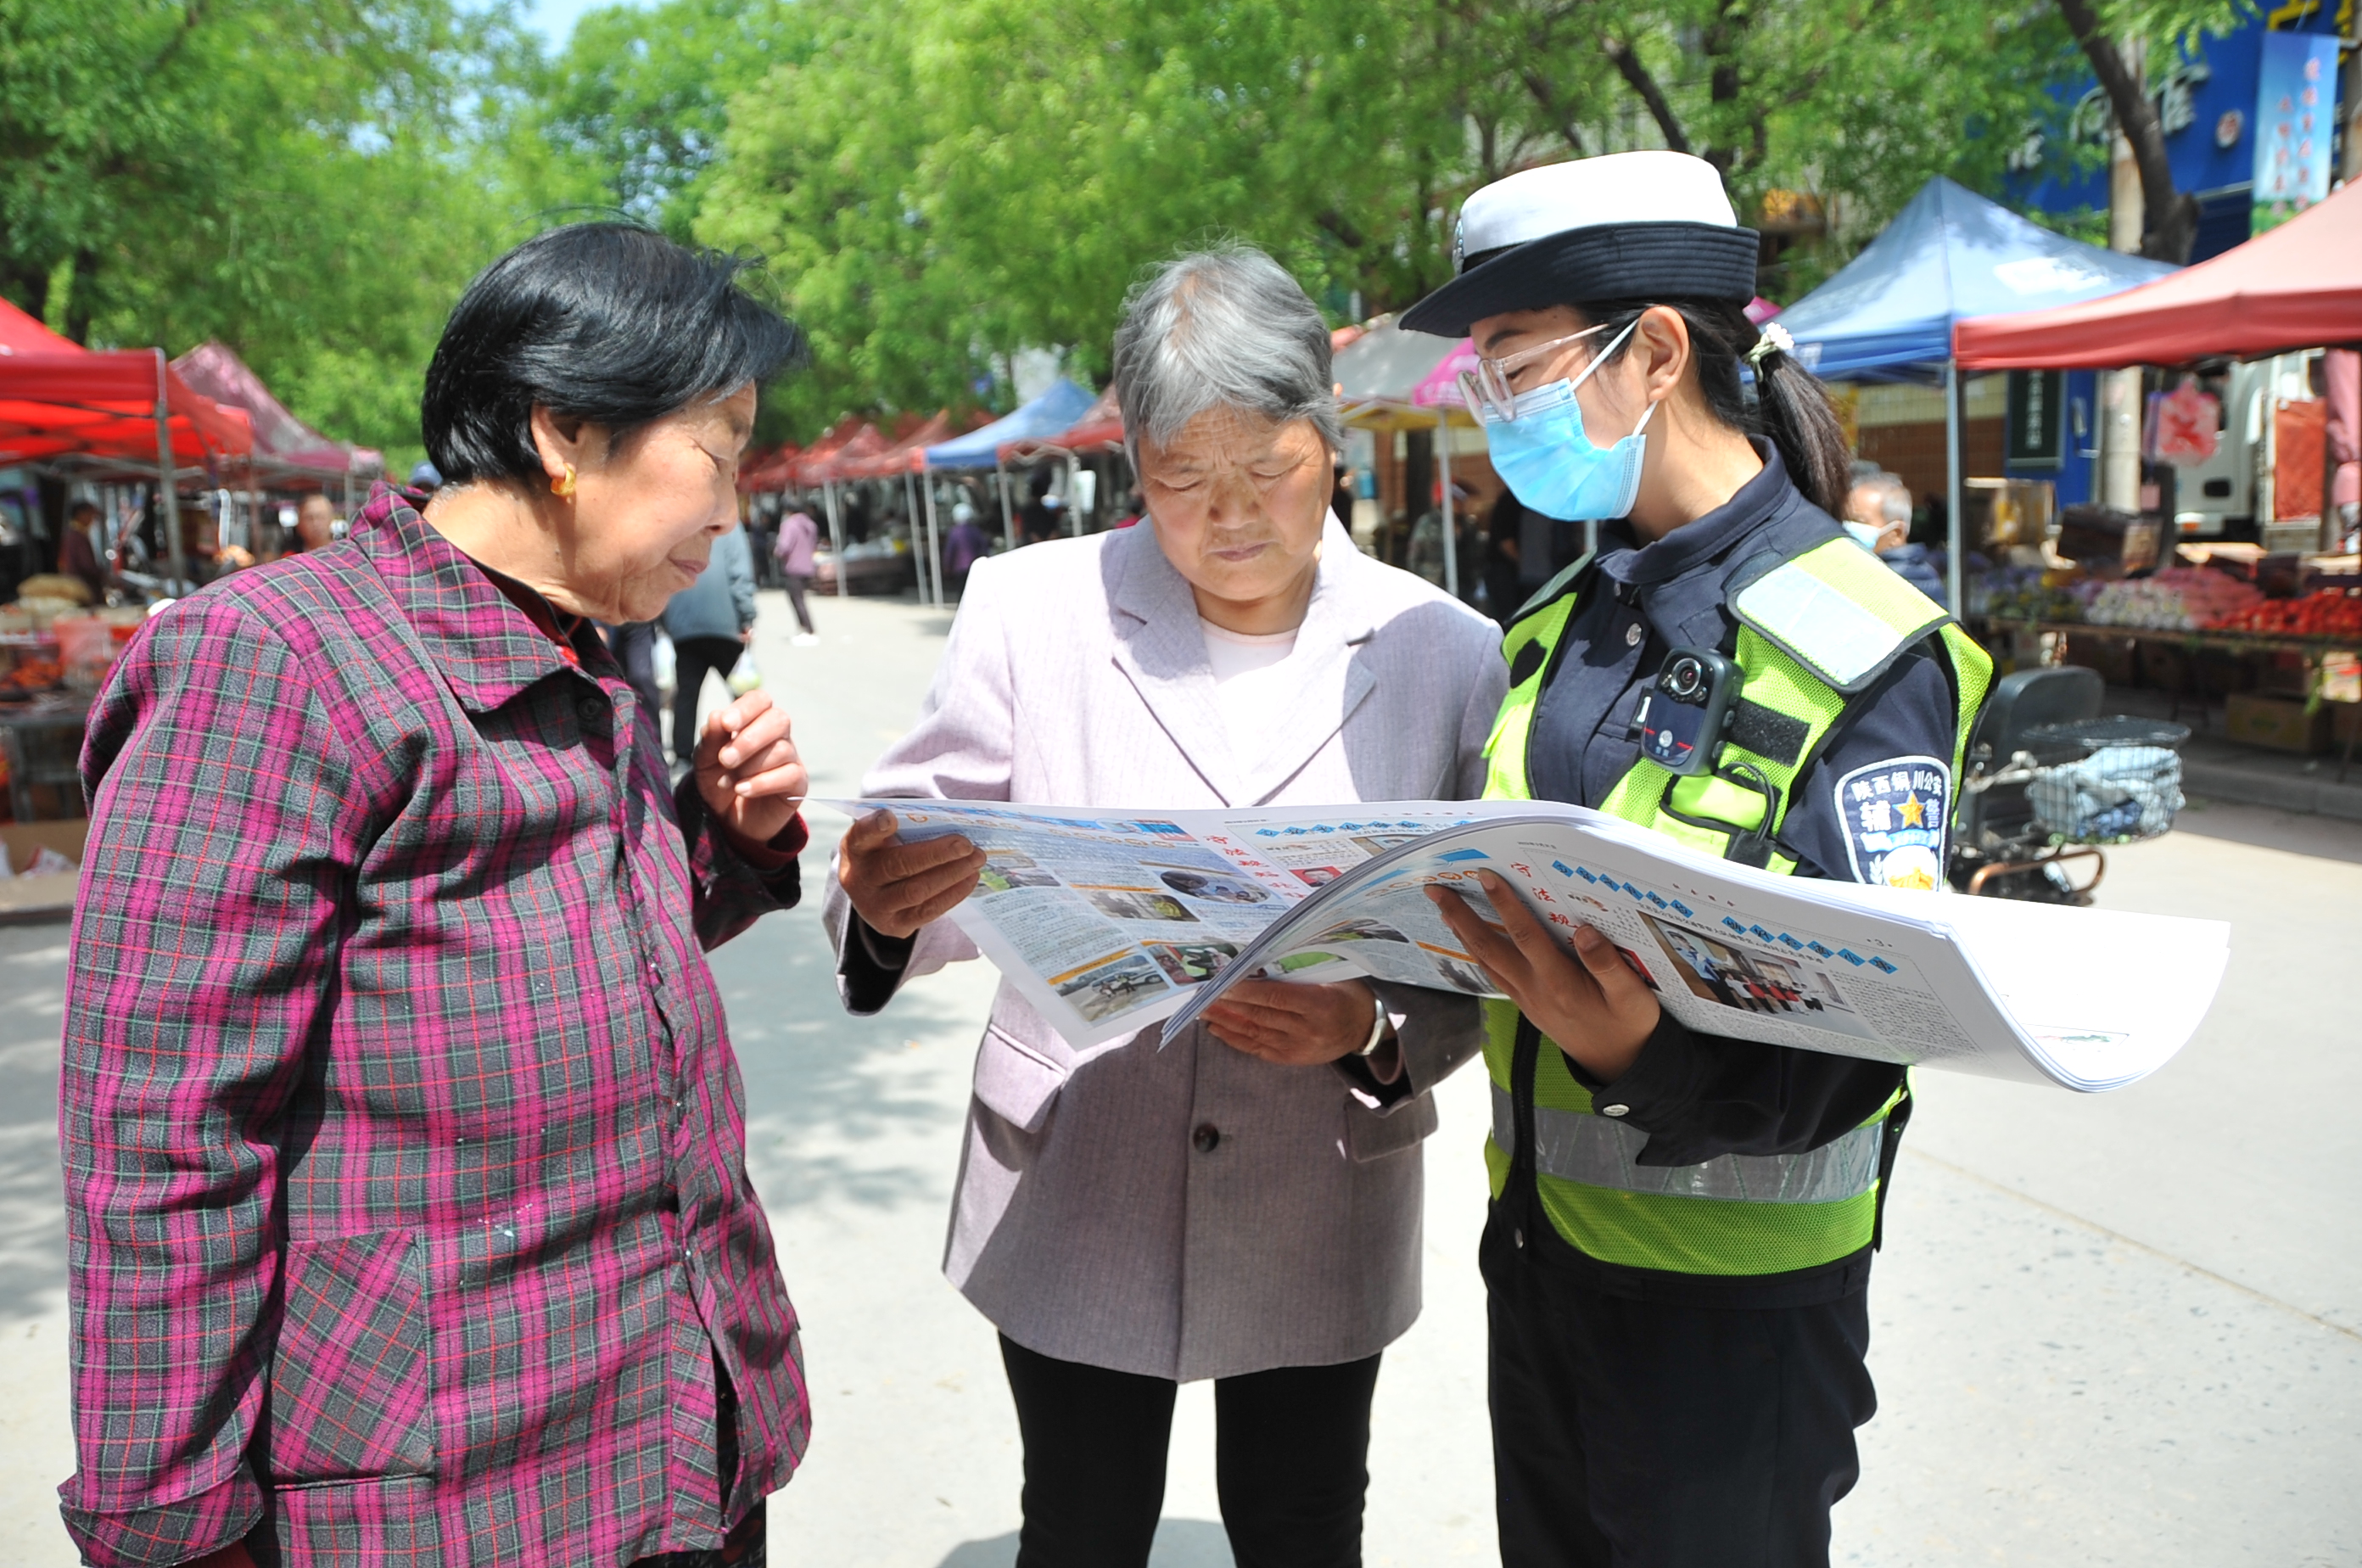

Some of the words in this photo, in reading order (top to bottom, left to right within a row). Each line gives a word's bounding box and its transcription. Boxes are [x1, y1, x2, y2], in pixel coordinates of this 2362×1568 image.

[1850, 770, 1943, 802] 陕西铜川公安
